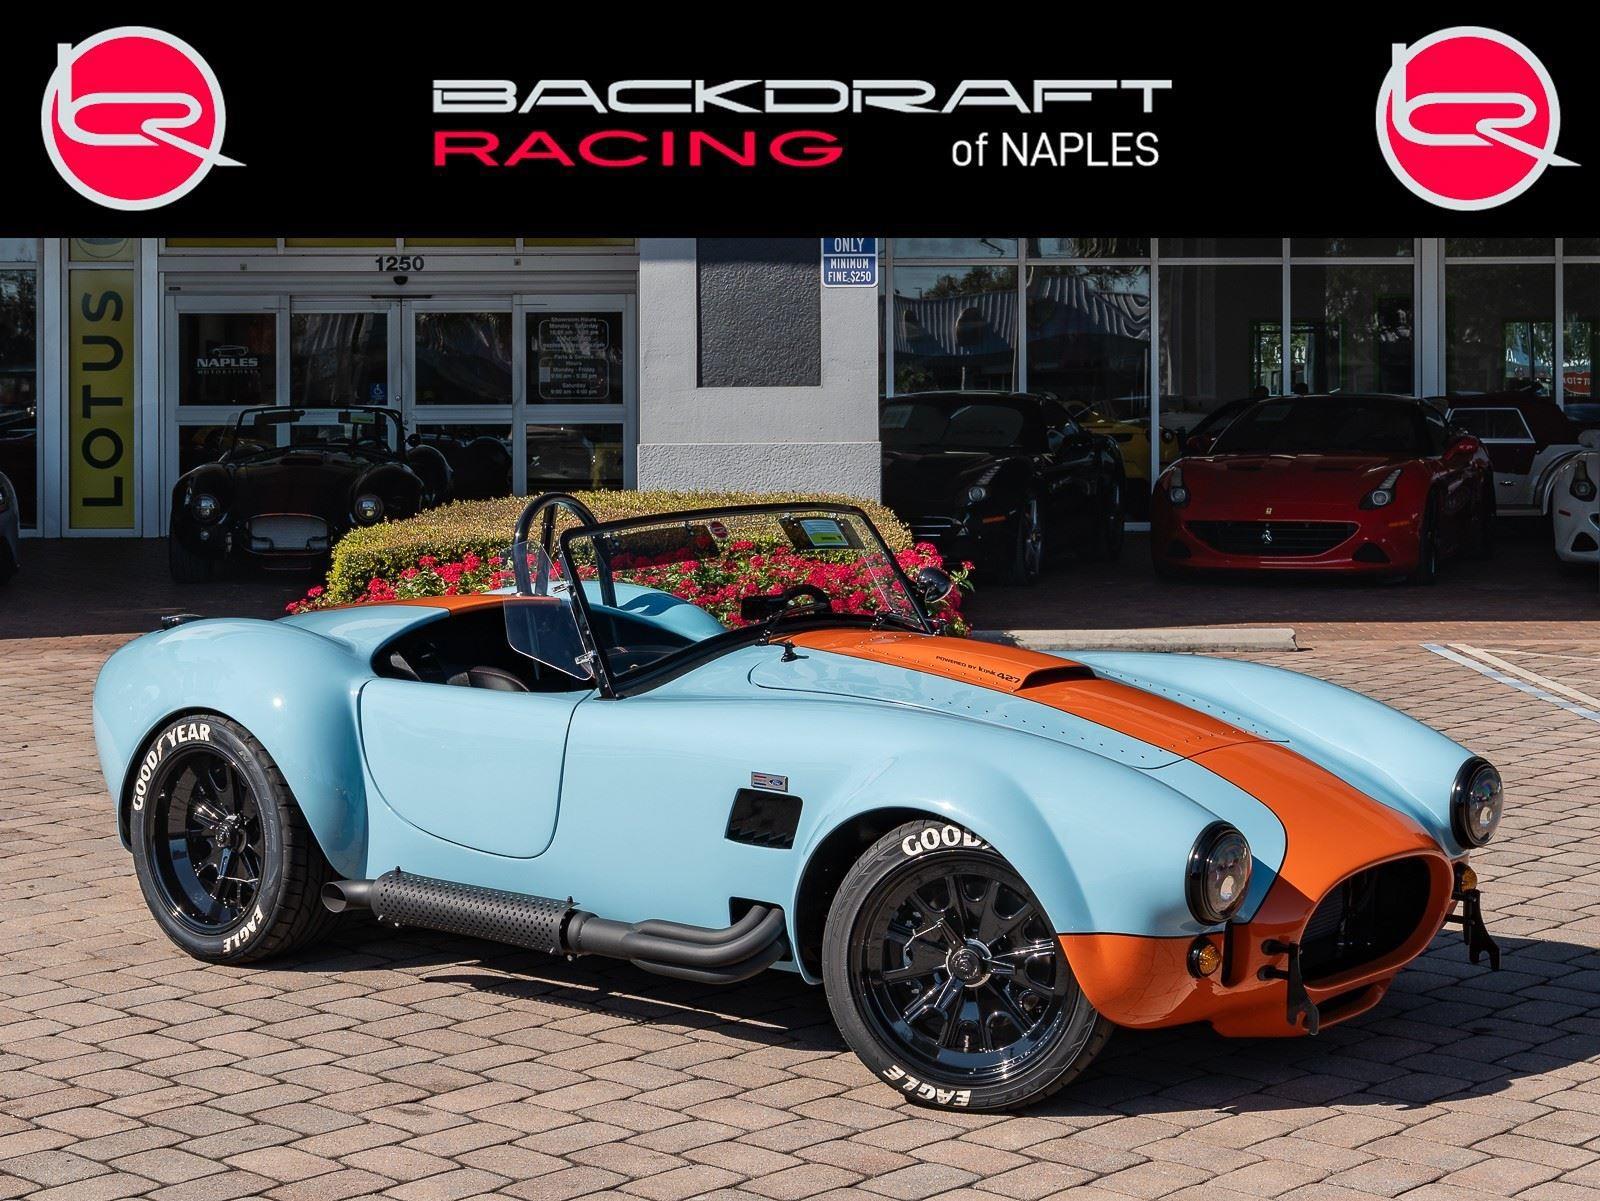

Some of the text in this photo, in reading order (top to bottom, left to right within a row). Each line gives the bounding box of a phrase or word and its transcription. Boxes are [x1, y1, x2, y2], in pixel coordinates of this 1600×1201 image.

[834, 238, 864, 252] ONLY
[375, 256, 425, 271] 1250
[830, 258, 869, 269] MINIMUM
[850, 270, 872, 283] $250
[197, 357, 258, 367] NAPLES
[82, 290, 124, 508] LOTUS
[997, 672, 1020, 684] 427
[223, 904, 264, 953] EAGLE
[882, 1064, 972, 1107] EAGLE
